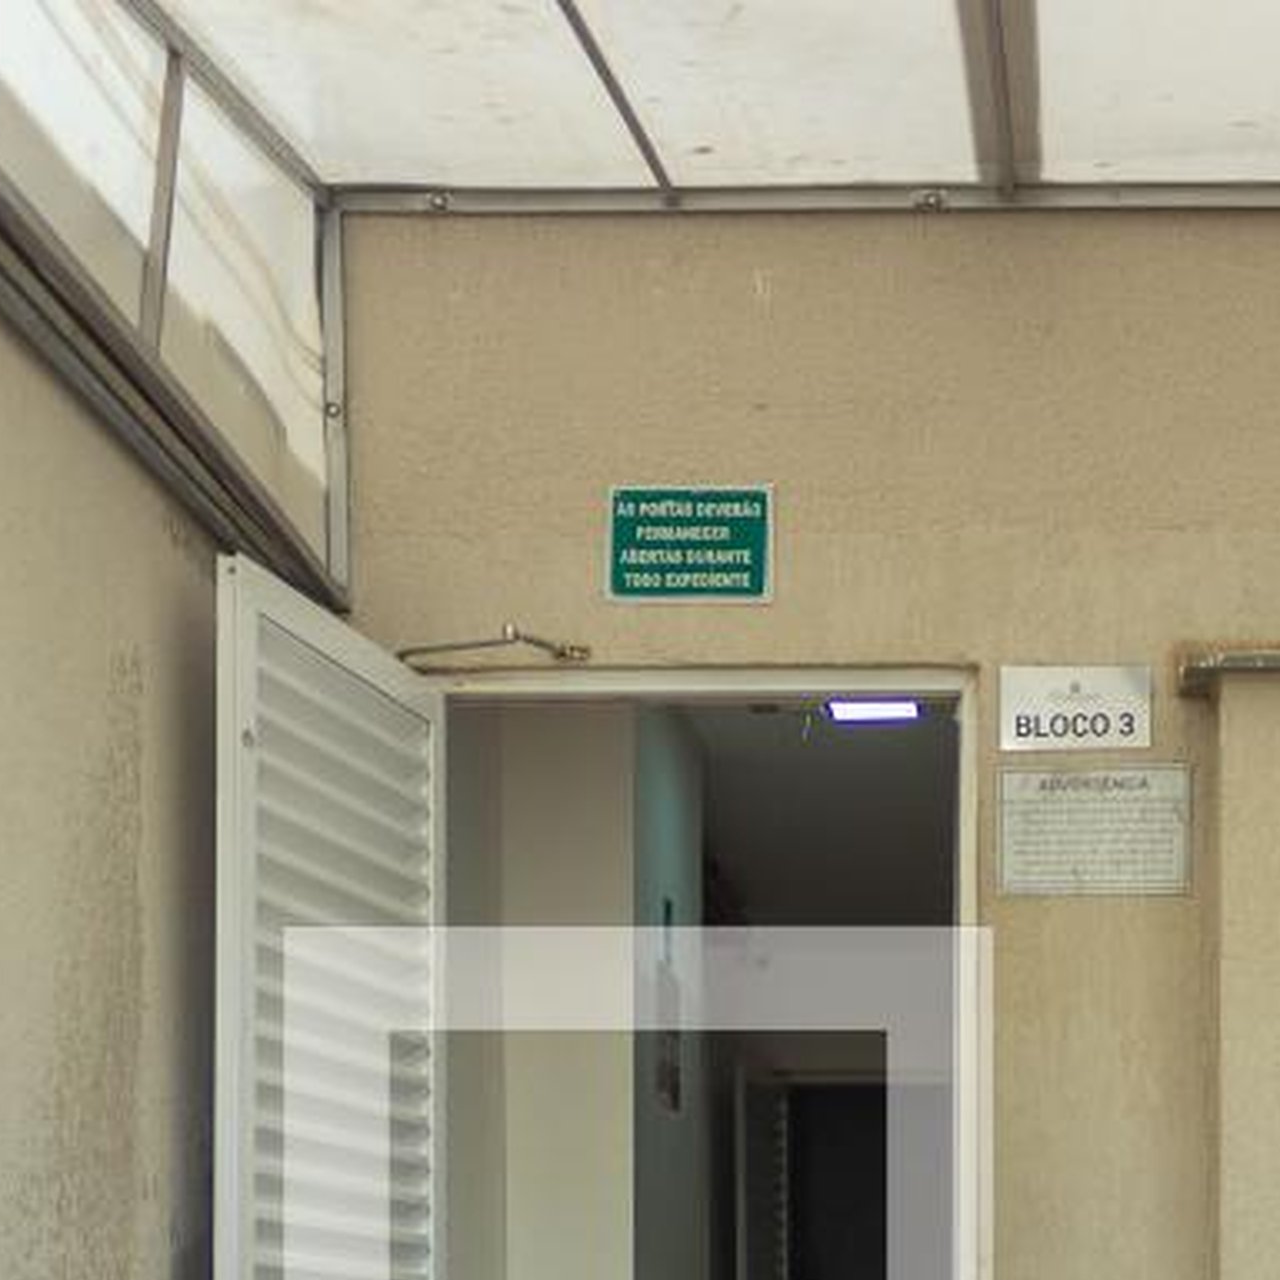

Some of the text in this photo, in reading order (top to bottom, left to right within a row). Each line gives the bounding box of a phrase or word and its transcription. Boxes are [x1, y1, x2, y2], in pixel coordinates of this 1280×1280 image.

[639, 500, 693, 517] PORTAS
[636, 526, 730, 540] PERMANECER
[620, 549, 752, 564] ABERTAS DURANTE
[625, 572, 751, 587] TODO EXPEDIENTE
[1015, 712, 1135, 738] BLOCO 3
